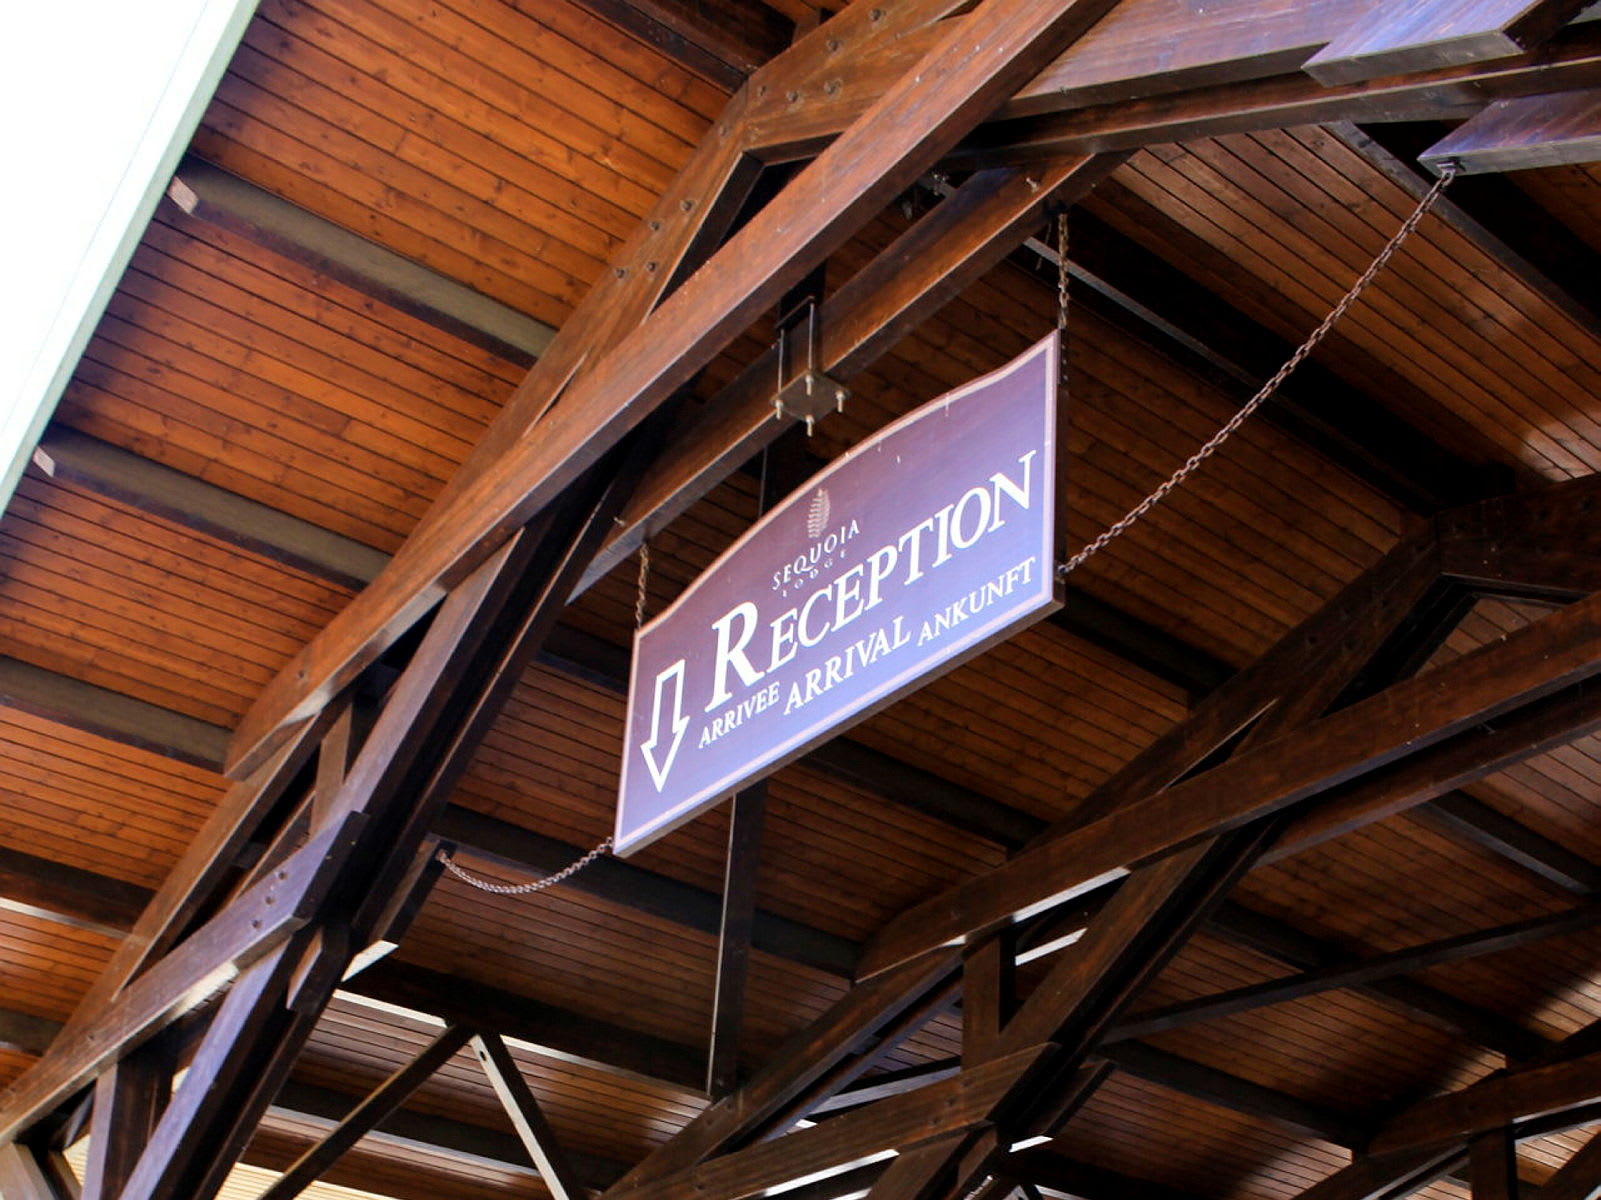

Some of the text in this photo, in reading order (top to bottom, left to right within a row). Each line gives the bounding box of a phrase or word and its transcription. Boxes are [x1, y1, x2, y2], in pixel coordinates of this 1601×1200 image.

[703, 449, 1036, 712] RECEPTION
[771, 519, 860, 591] SEQUOIA
[698, 556, 1036, 749] ARRIVEE ARRIVAL ANKUNFT
